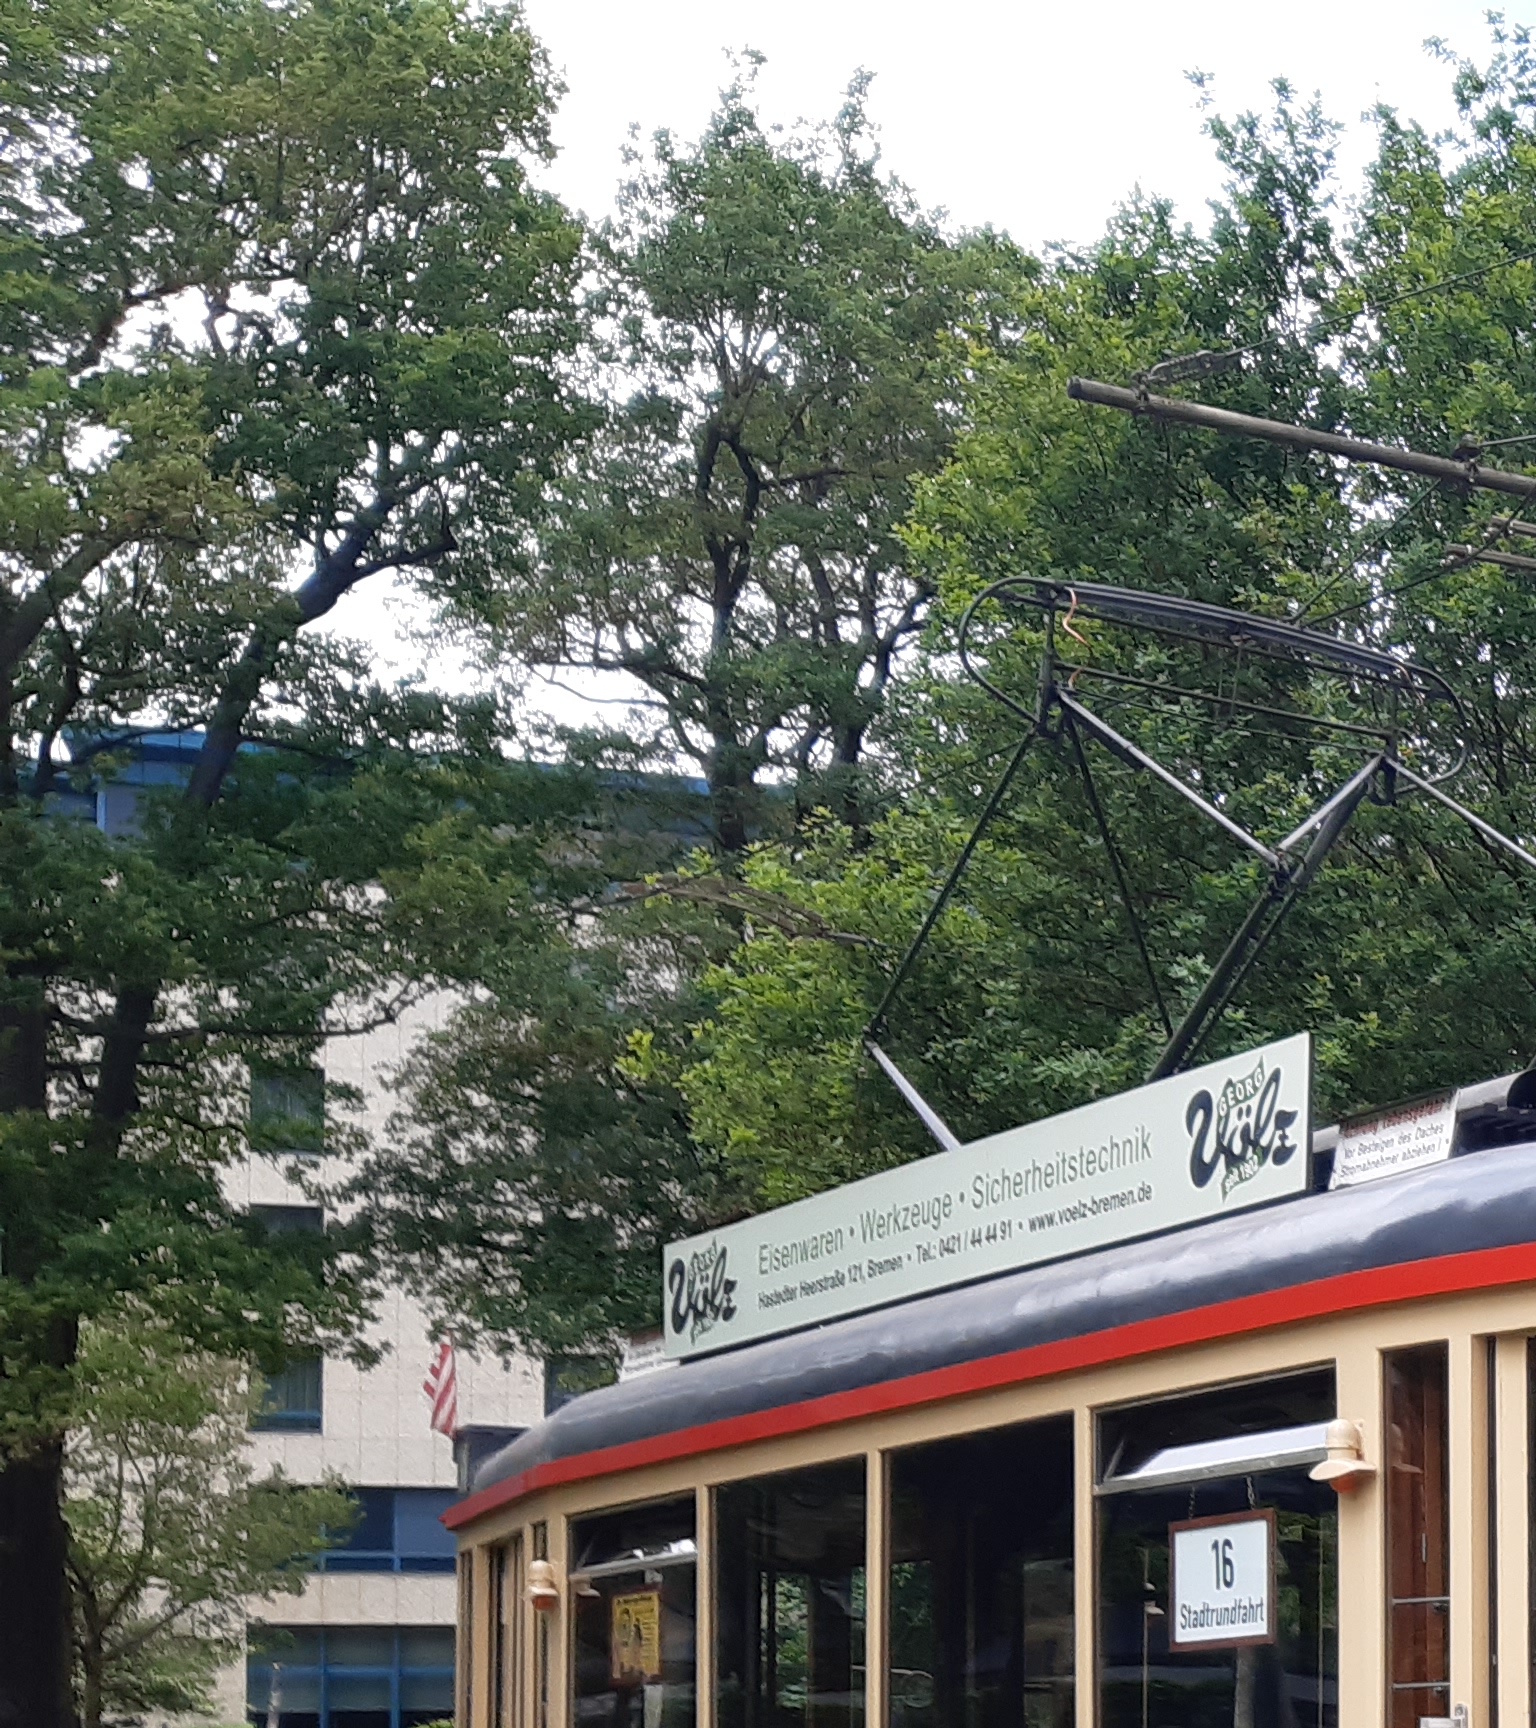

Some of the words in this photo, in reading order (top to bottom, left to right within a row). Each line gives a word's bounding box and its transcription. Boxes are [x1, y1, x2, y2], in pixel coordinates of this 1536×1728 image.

[1218, 1067, 1263, 1117] GEORG
[758, 1226, 844, 1275] Eisenwaren
[859, 1192, 953, 1244] Werkzeuge
[970, 1123, 1153, 1209] Sicherheitstechnik
[867, 1254, 903, 1279] Bremen
[1027, 1180, 1153, 1233] www.voelz-bremen.de
[1210, 1537, 1235, 1591] 16
[1179, 1596, 1265, 1630] Stadtrundfahrt
